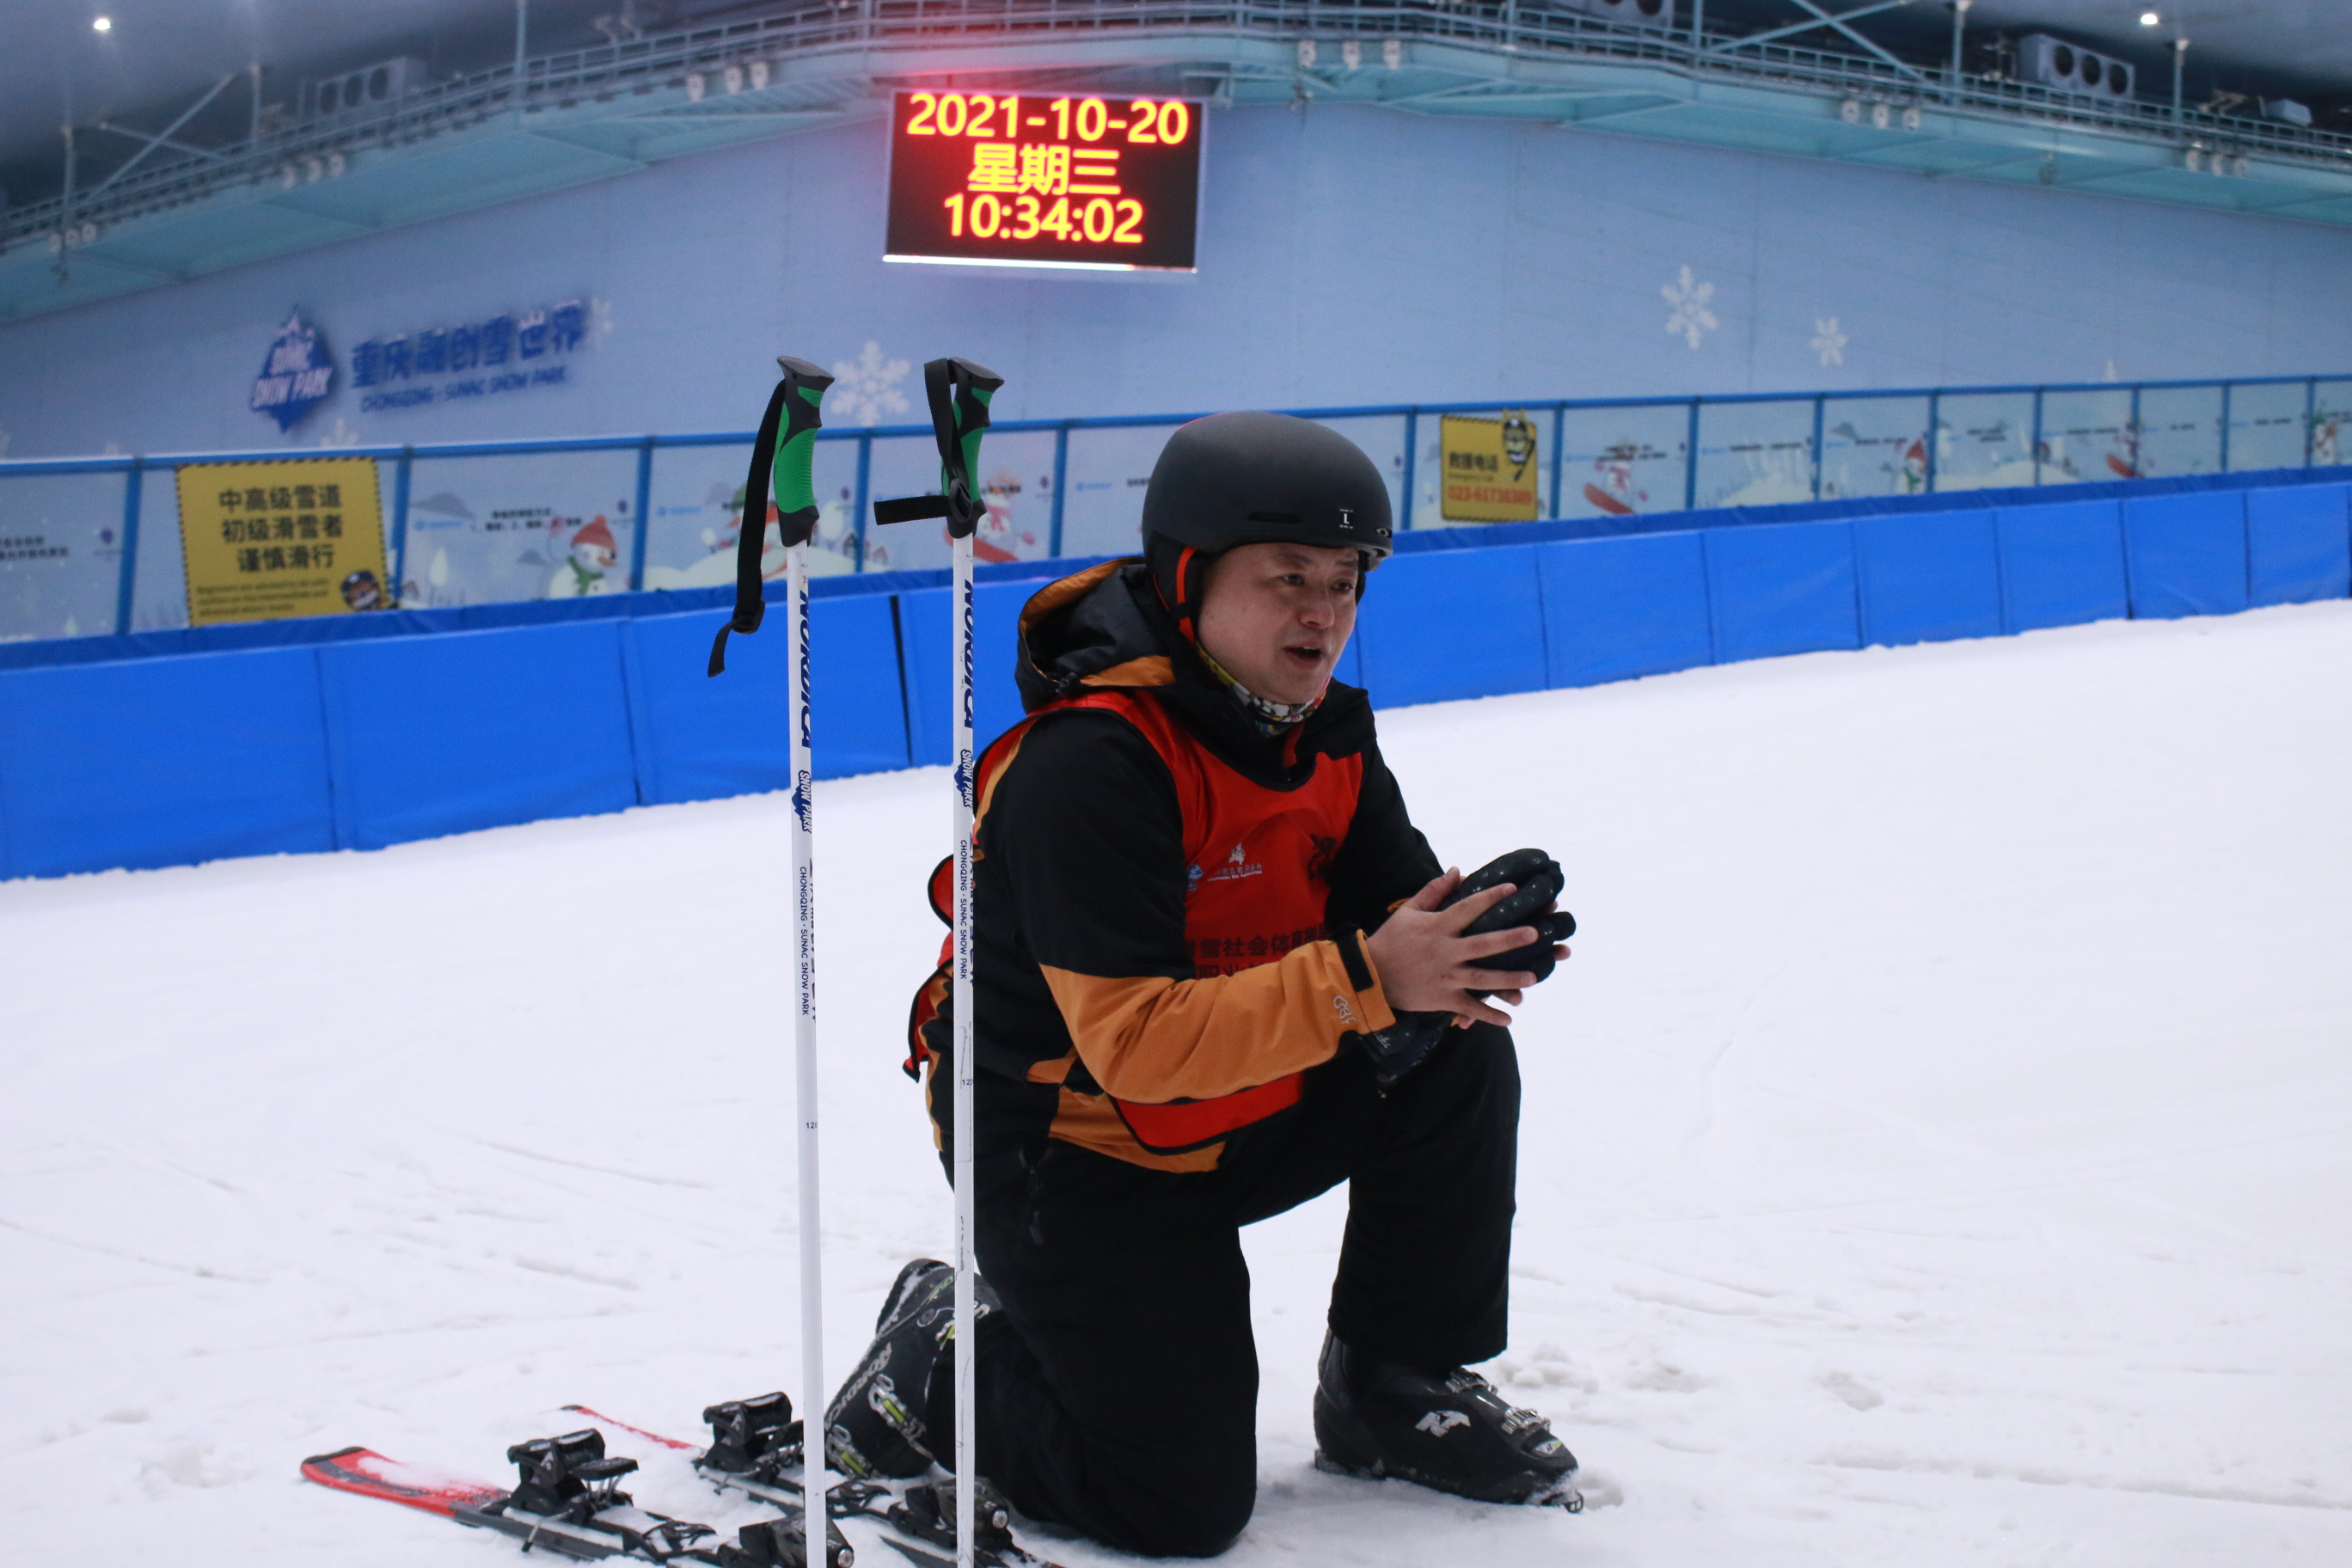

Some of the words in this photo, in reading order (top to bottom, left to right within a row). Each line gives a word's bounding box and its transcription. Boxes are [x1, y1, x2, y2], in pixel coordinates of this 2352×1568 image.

[907, 93, 1189, 144] 2021-10-20
[968, 143, 1121, 195] 星期三
[944, 193, 1143, 243] 10:34:02
[219, 485, 342, 512] 中高级雪道
[223, 515, 342, 542] 初级滑雪者
[237, 544, 334, 572] 谨慎滑行
[960, 749, 973, 779] SNOW
[798, 769, 812, 801] SNOW
[963, 777, 973, 808] PARK
[801, 803, 812, 834] PARK
